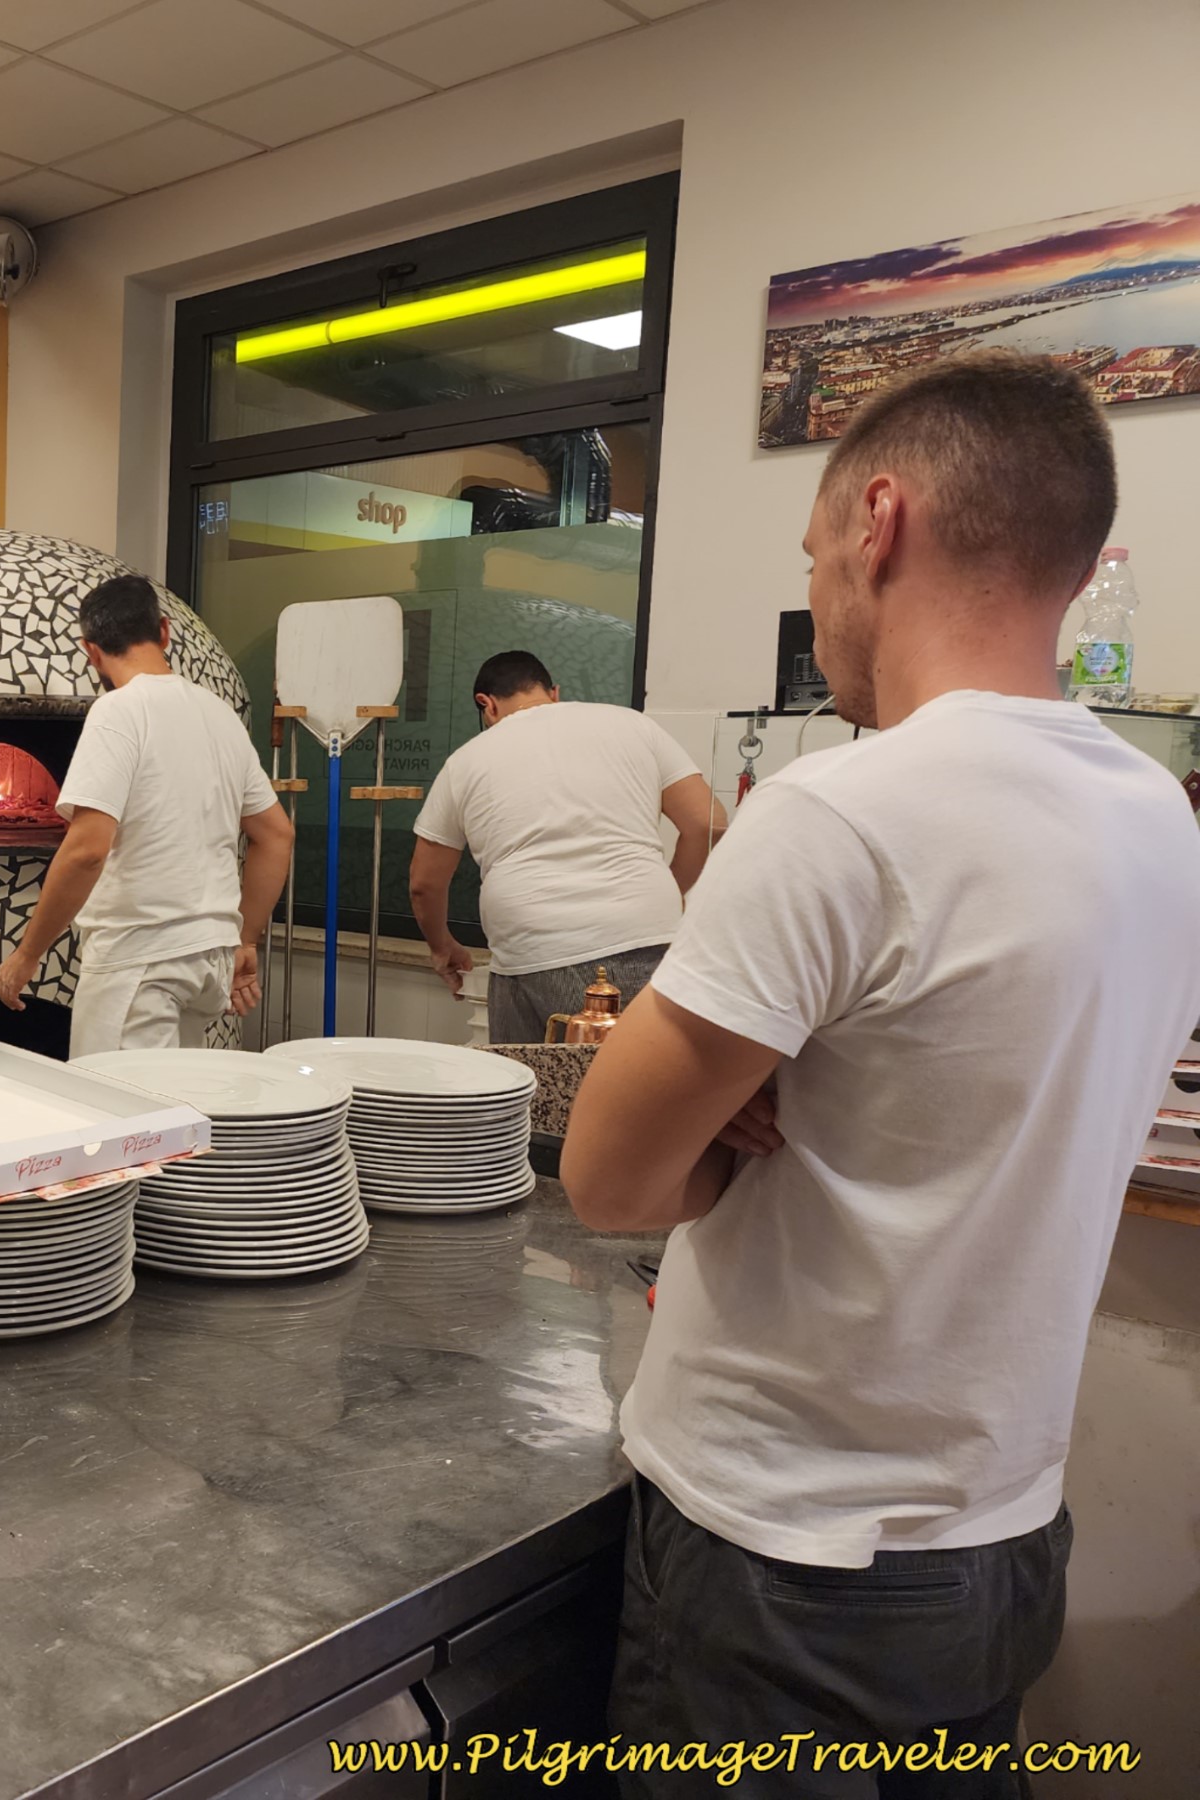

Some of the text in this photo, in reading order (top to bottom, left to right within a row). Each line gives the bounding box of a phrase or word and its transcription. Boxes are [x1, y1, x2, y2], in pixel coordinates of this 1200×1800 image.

[357, 491, 407, 534] shop
[121, 1133, 163, 1159] Pizza
[15, 1155, 63, 1182] Pizza
